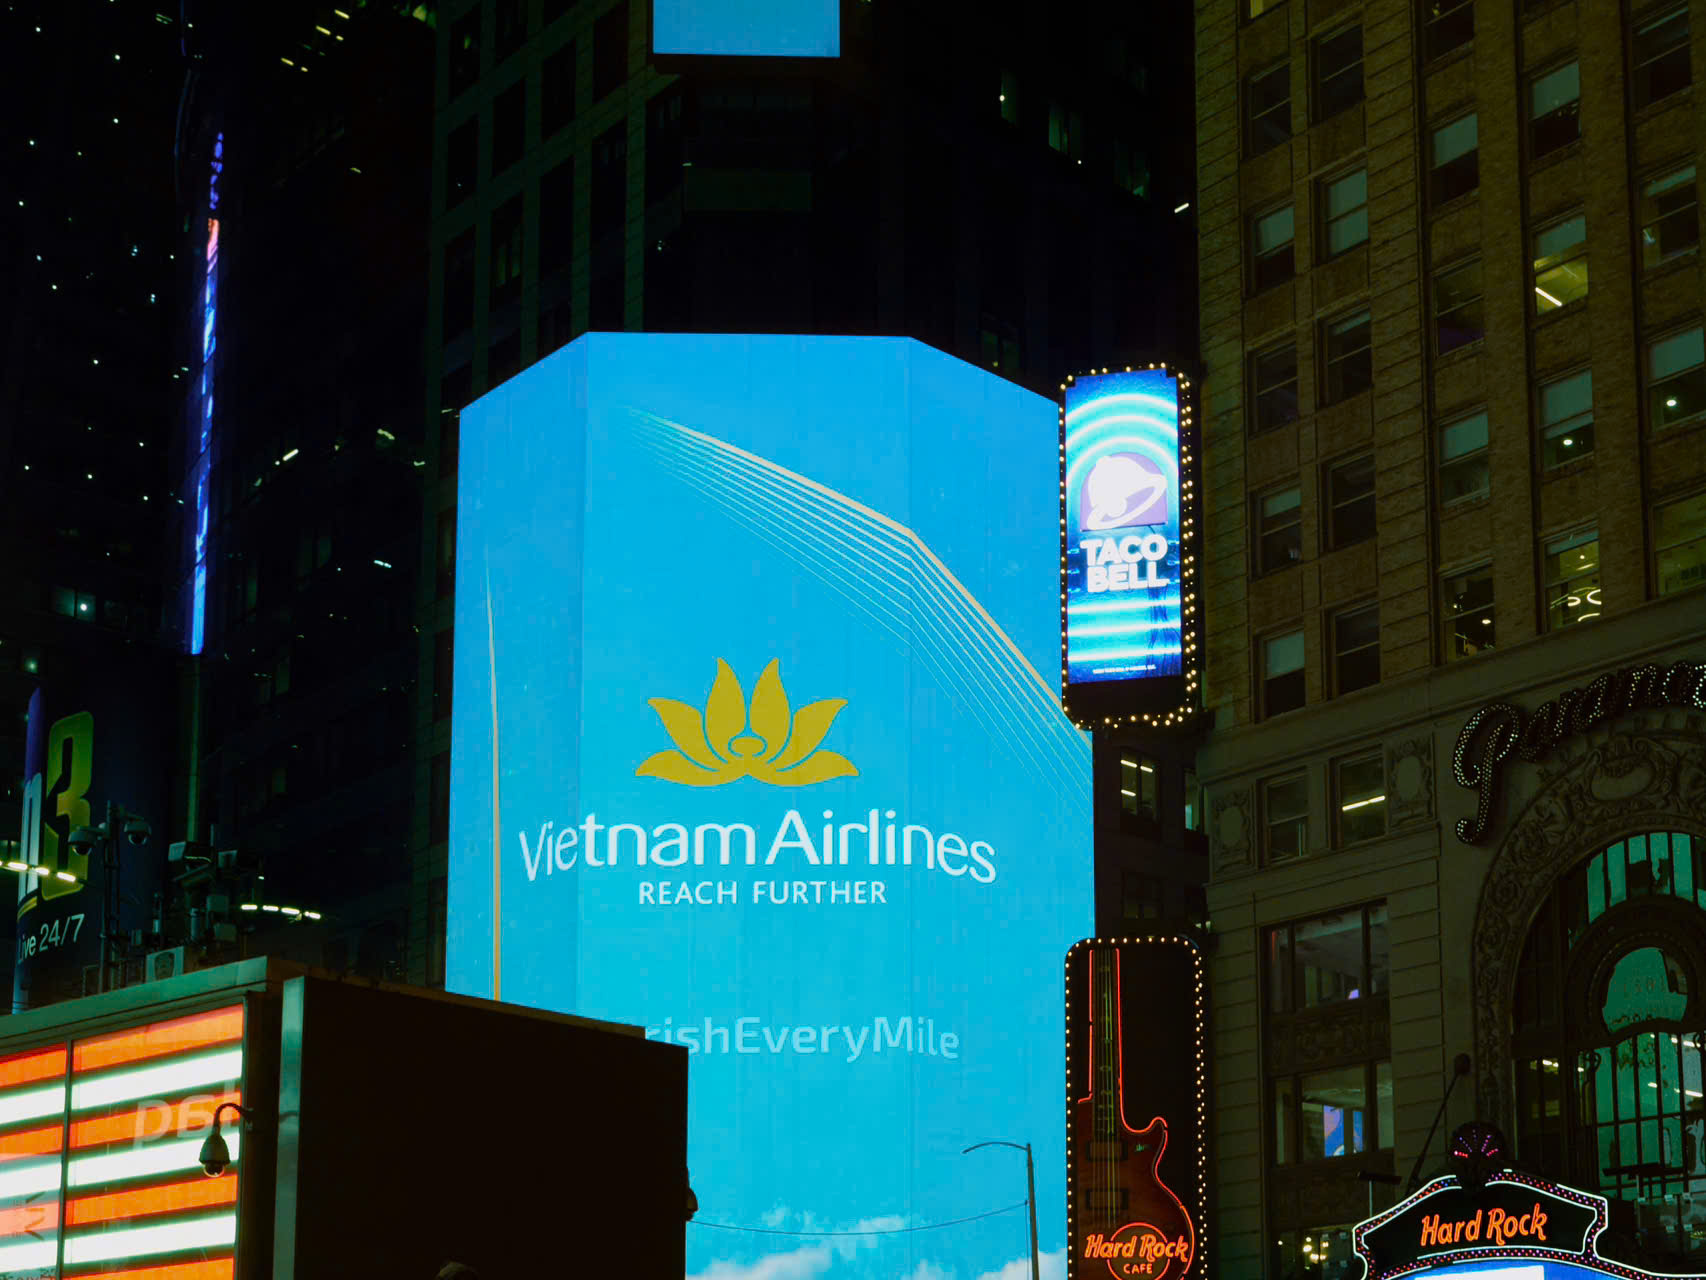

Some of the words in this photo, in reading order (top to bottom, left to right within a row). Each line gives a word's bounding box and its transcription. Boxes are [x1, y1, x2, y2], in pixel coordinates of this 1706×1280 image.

[1080, 534, 1168, 566] TACO
[1087, 561, 1169, 594] BELL
[519, 812, 755, 882] Vietnam
[766, 808, 997, 883] Airlines
[638, 880, 738, 904] REACH
[752, 880, 887, 904] FURTHER
[39, 913, 86, 952] 24/7
[1420, 1212, 1480, 1247] Hard
[1486, 1202, 1549, 1245] Rock
[1084, 1233, 1138, 1259] Hard
[1139, 1233, 1189, 1263] Rock
